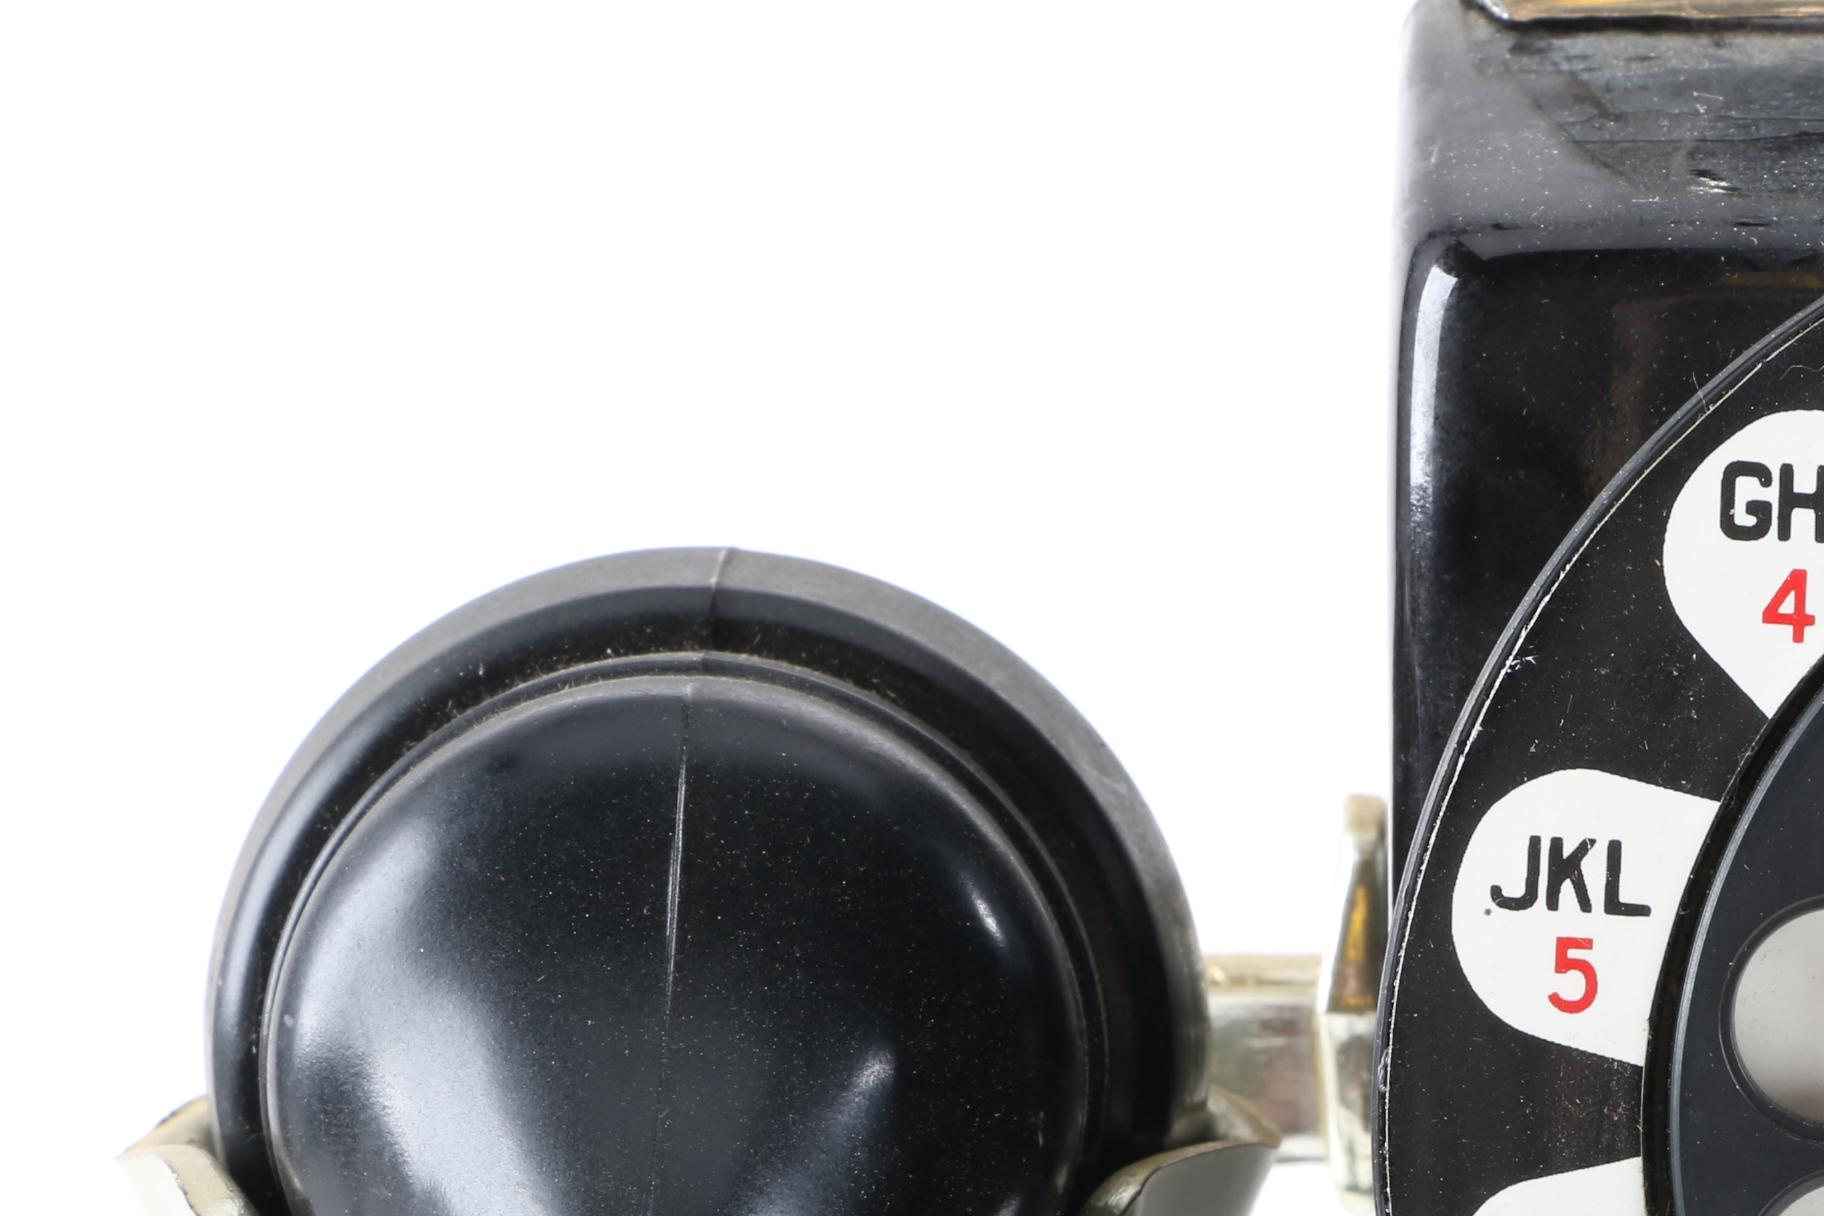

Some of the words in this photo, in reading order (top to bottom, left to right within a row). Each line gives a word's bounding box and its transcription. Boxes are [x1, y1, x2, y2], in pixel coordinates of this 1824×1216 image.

[1762, 569, 1815, 643] 4
[1490, 835, 1652, 917] JKL
[1548, 937, 1598, 1014] 5
